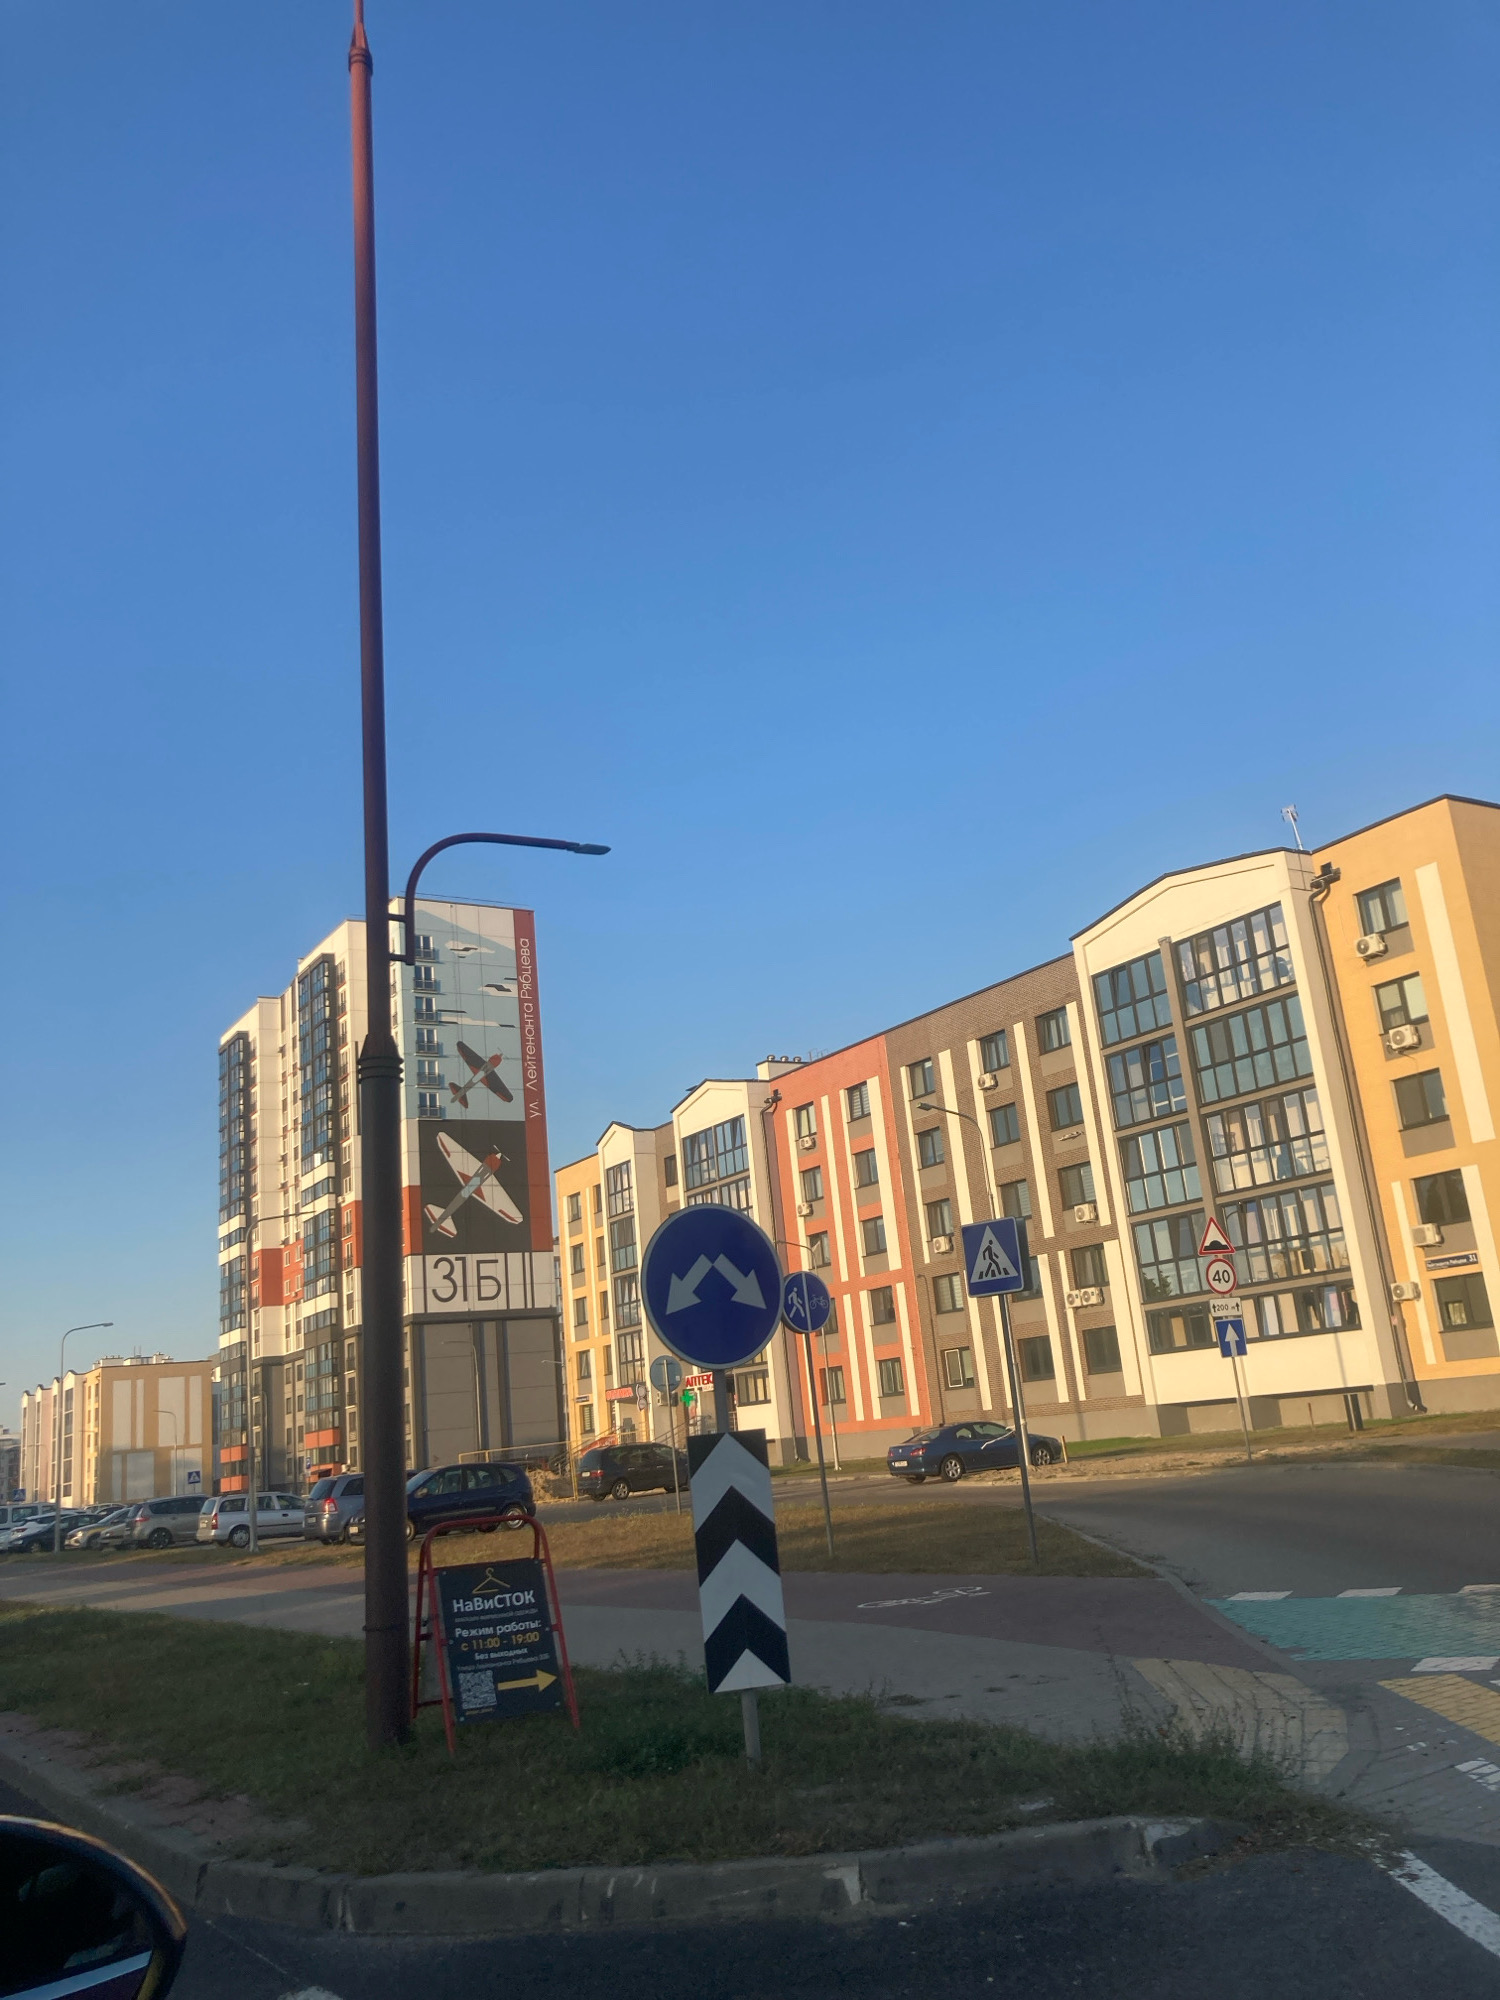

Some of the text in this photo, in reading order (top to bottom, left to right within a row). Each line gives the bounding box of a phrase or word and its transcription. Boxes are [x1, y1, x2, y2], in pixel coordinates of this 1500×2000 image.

[518, 938, 542, 1119] ул. Лейтенанта Рябцева
[1468, 1254, 1477, 1262] 31
[432, 1256, 501, 1303] 31Б
[1212, 1269, 1230, 1283] 40
[1216, 1304, 1229, 1312] 200
[686, 1373, 714, 1387] АПТЕК
[453, 1590, 535, 1613] НаВиСТОК
[455, 1620, 542, 1638] Режим работы:
[472, 1637, 500, 1650] 11:00
[512, 1631, 540, 1645] 19:00
